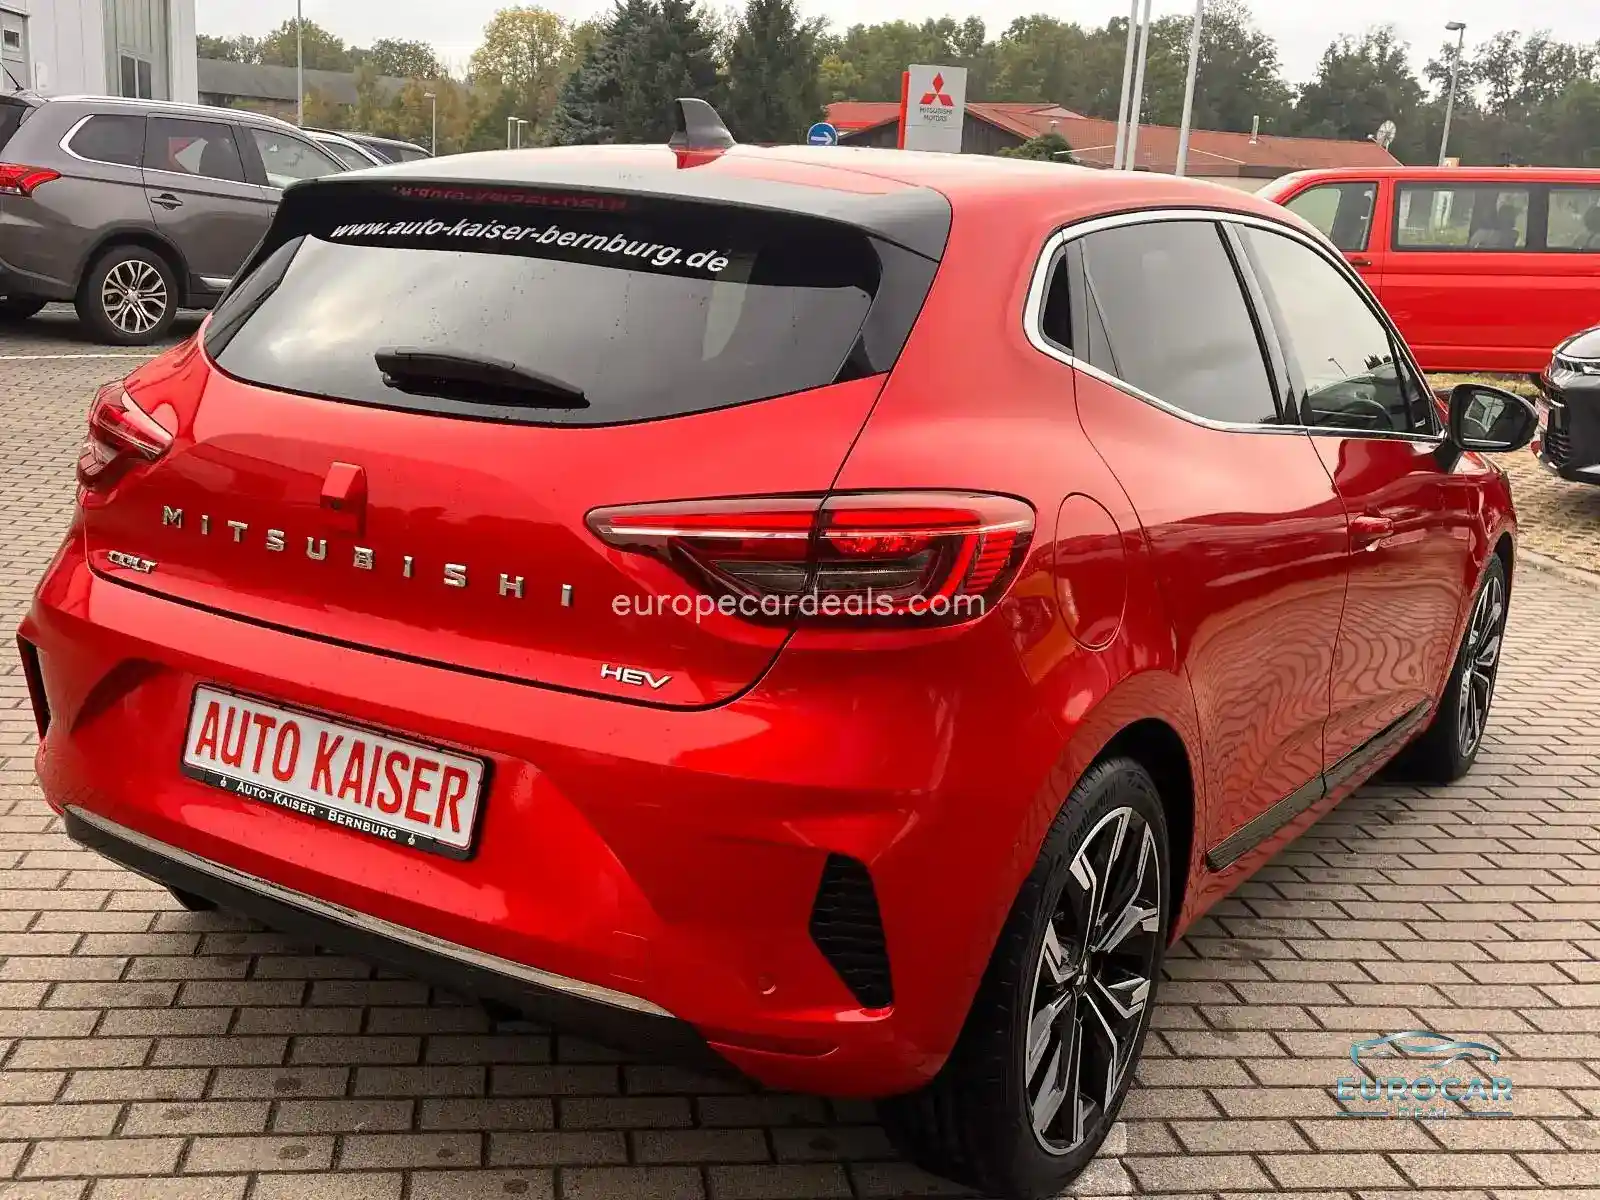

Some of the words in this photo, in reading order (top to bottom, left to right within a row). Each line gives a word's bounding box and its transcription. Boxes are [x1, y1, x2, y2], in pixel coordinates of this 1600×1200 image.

[919, 106, 953, 115] MITSUBISHI
[329, 217, 729, 274] www.auto-kaiser-bernburg.de
[162, 504, 575, 608] MITSUBISHI
[600, 663, 671, 690] HEV
[195, 701, 301, 783] AUTO
[310, 730, 470, 834] KAISER
